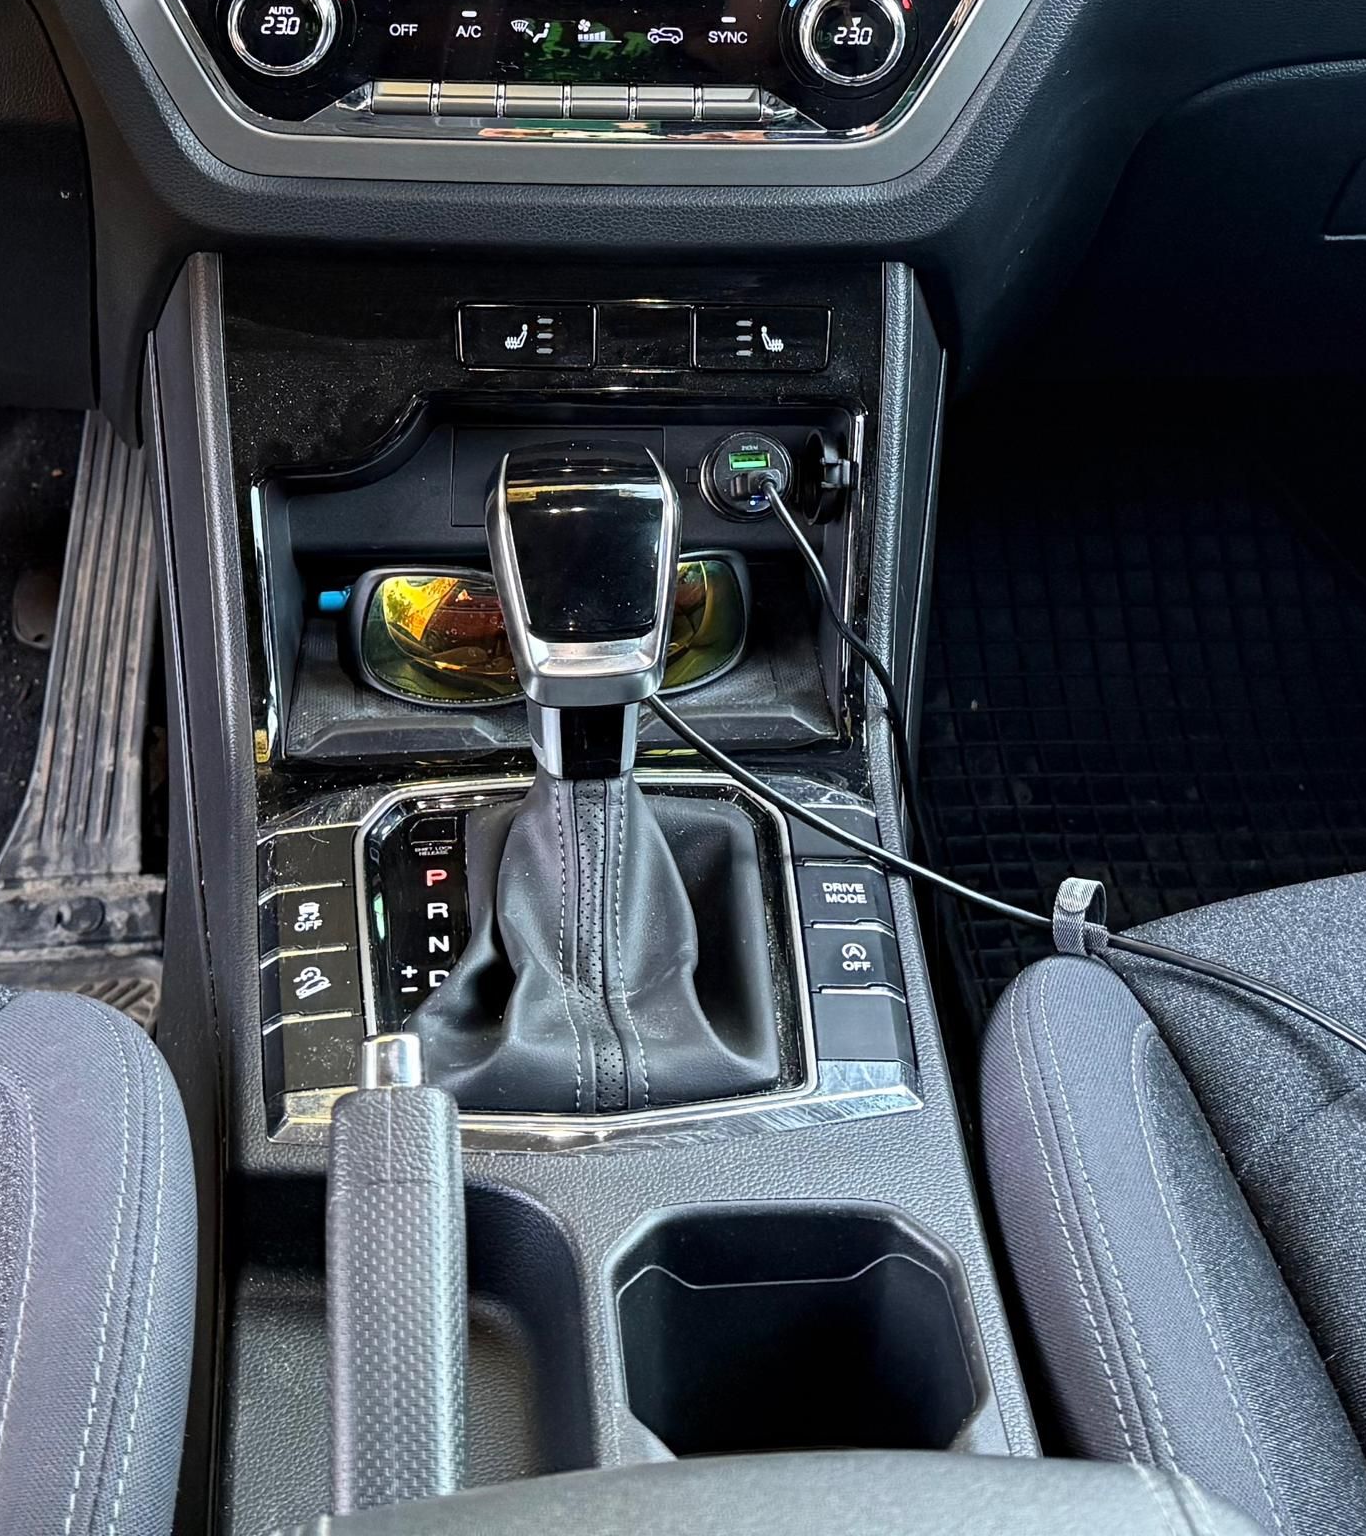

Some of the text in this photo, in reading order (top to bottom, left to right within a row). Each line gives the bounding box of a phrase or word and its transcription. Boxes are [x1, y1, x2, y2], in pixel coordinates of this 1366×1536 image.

[268, 5, 294, 16] AUTO
[260, 16, 300, 36] 23.0
[388, 23, 418, 37] OFF
[455, 24, 481, 38] A/C
[707, 29, 748, 44] SYNC
[833, 25, 873, 46] 23.0
[426, 868, 447, 886] P
[822, 882, 865, 893] DRIVE
[825, 893, 867, 904] MODE
[426, 902, 448, 919] R
[293, 919, 323, 932] OFF
[428, 935, 450, 953] N
[841, 960, 871, 972] OFF
[428, 969, 449, 987] D
